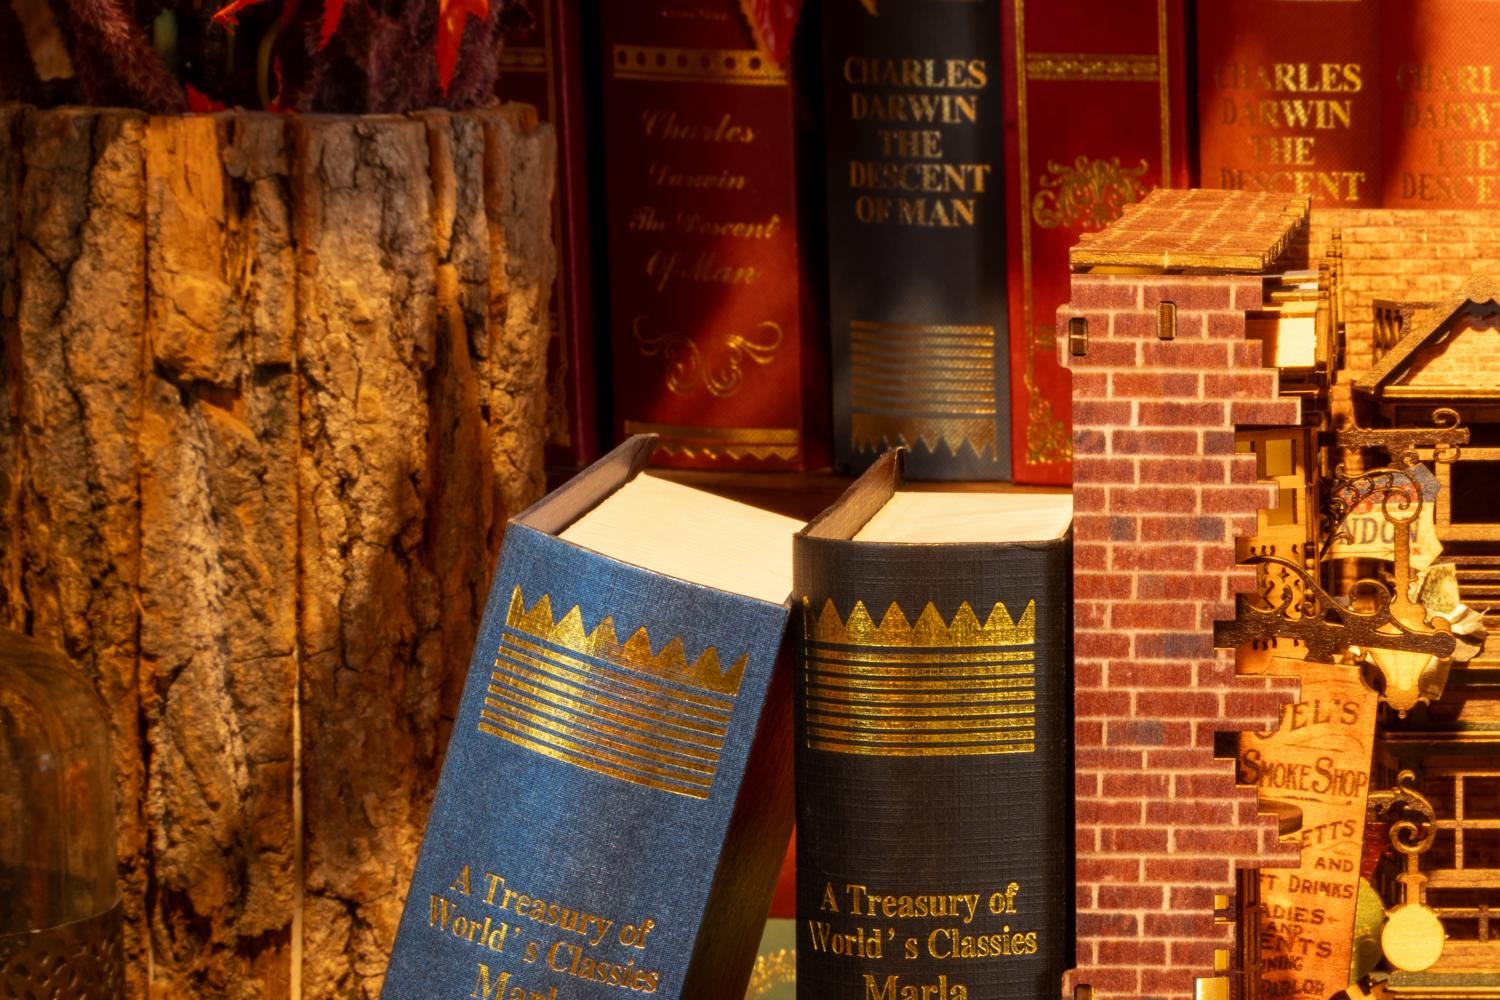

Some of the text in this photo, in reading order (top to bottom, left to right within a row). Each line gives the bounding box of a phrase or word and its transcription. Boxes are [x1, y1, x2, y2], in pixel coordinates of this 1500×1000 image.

[844, 56, 988, 89] CHARLES
[1215, 62, 1363, 93] CHARLES
[852, 92, 978, 124] DARWIN
[1221, 97, 1351, 129] DARWIN
[642, 109, 754, 143] Charles
[880, 130, 943, 159] THE
[1250, 133, 1315, 165] THE
[1432, 137, 1498, 169] THE
[850, 160, 991, 193] DESCENT
[855, 195, 976, 227] OF MAN
[1301, 819, 1357, 850] ETTS
[1314, 857, 1354, 873] AND
[820, 881, 1021, 924] A Treasury of
[1288, 874, 1354, 899] DRINKS
[449, 864, 656, 950] A Treasury of
[1260, 902, 1325, 925] ADIES
[1260, 932, 1332, 958] ENTS
